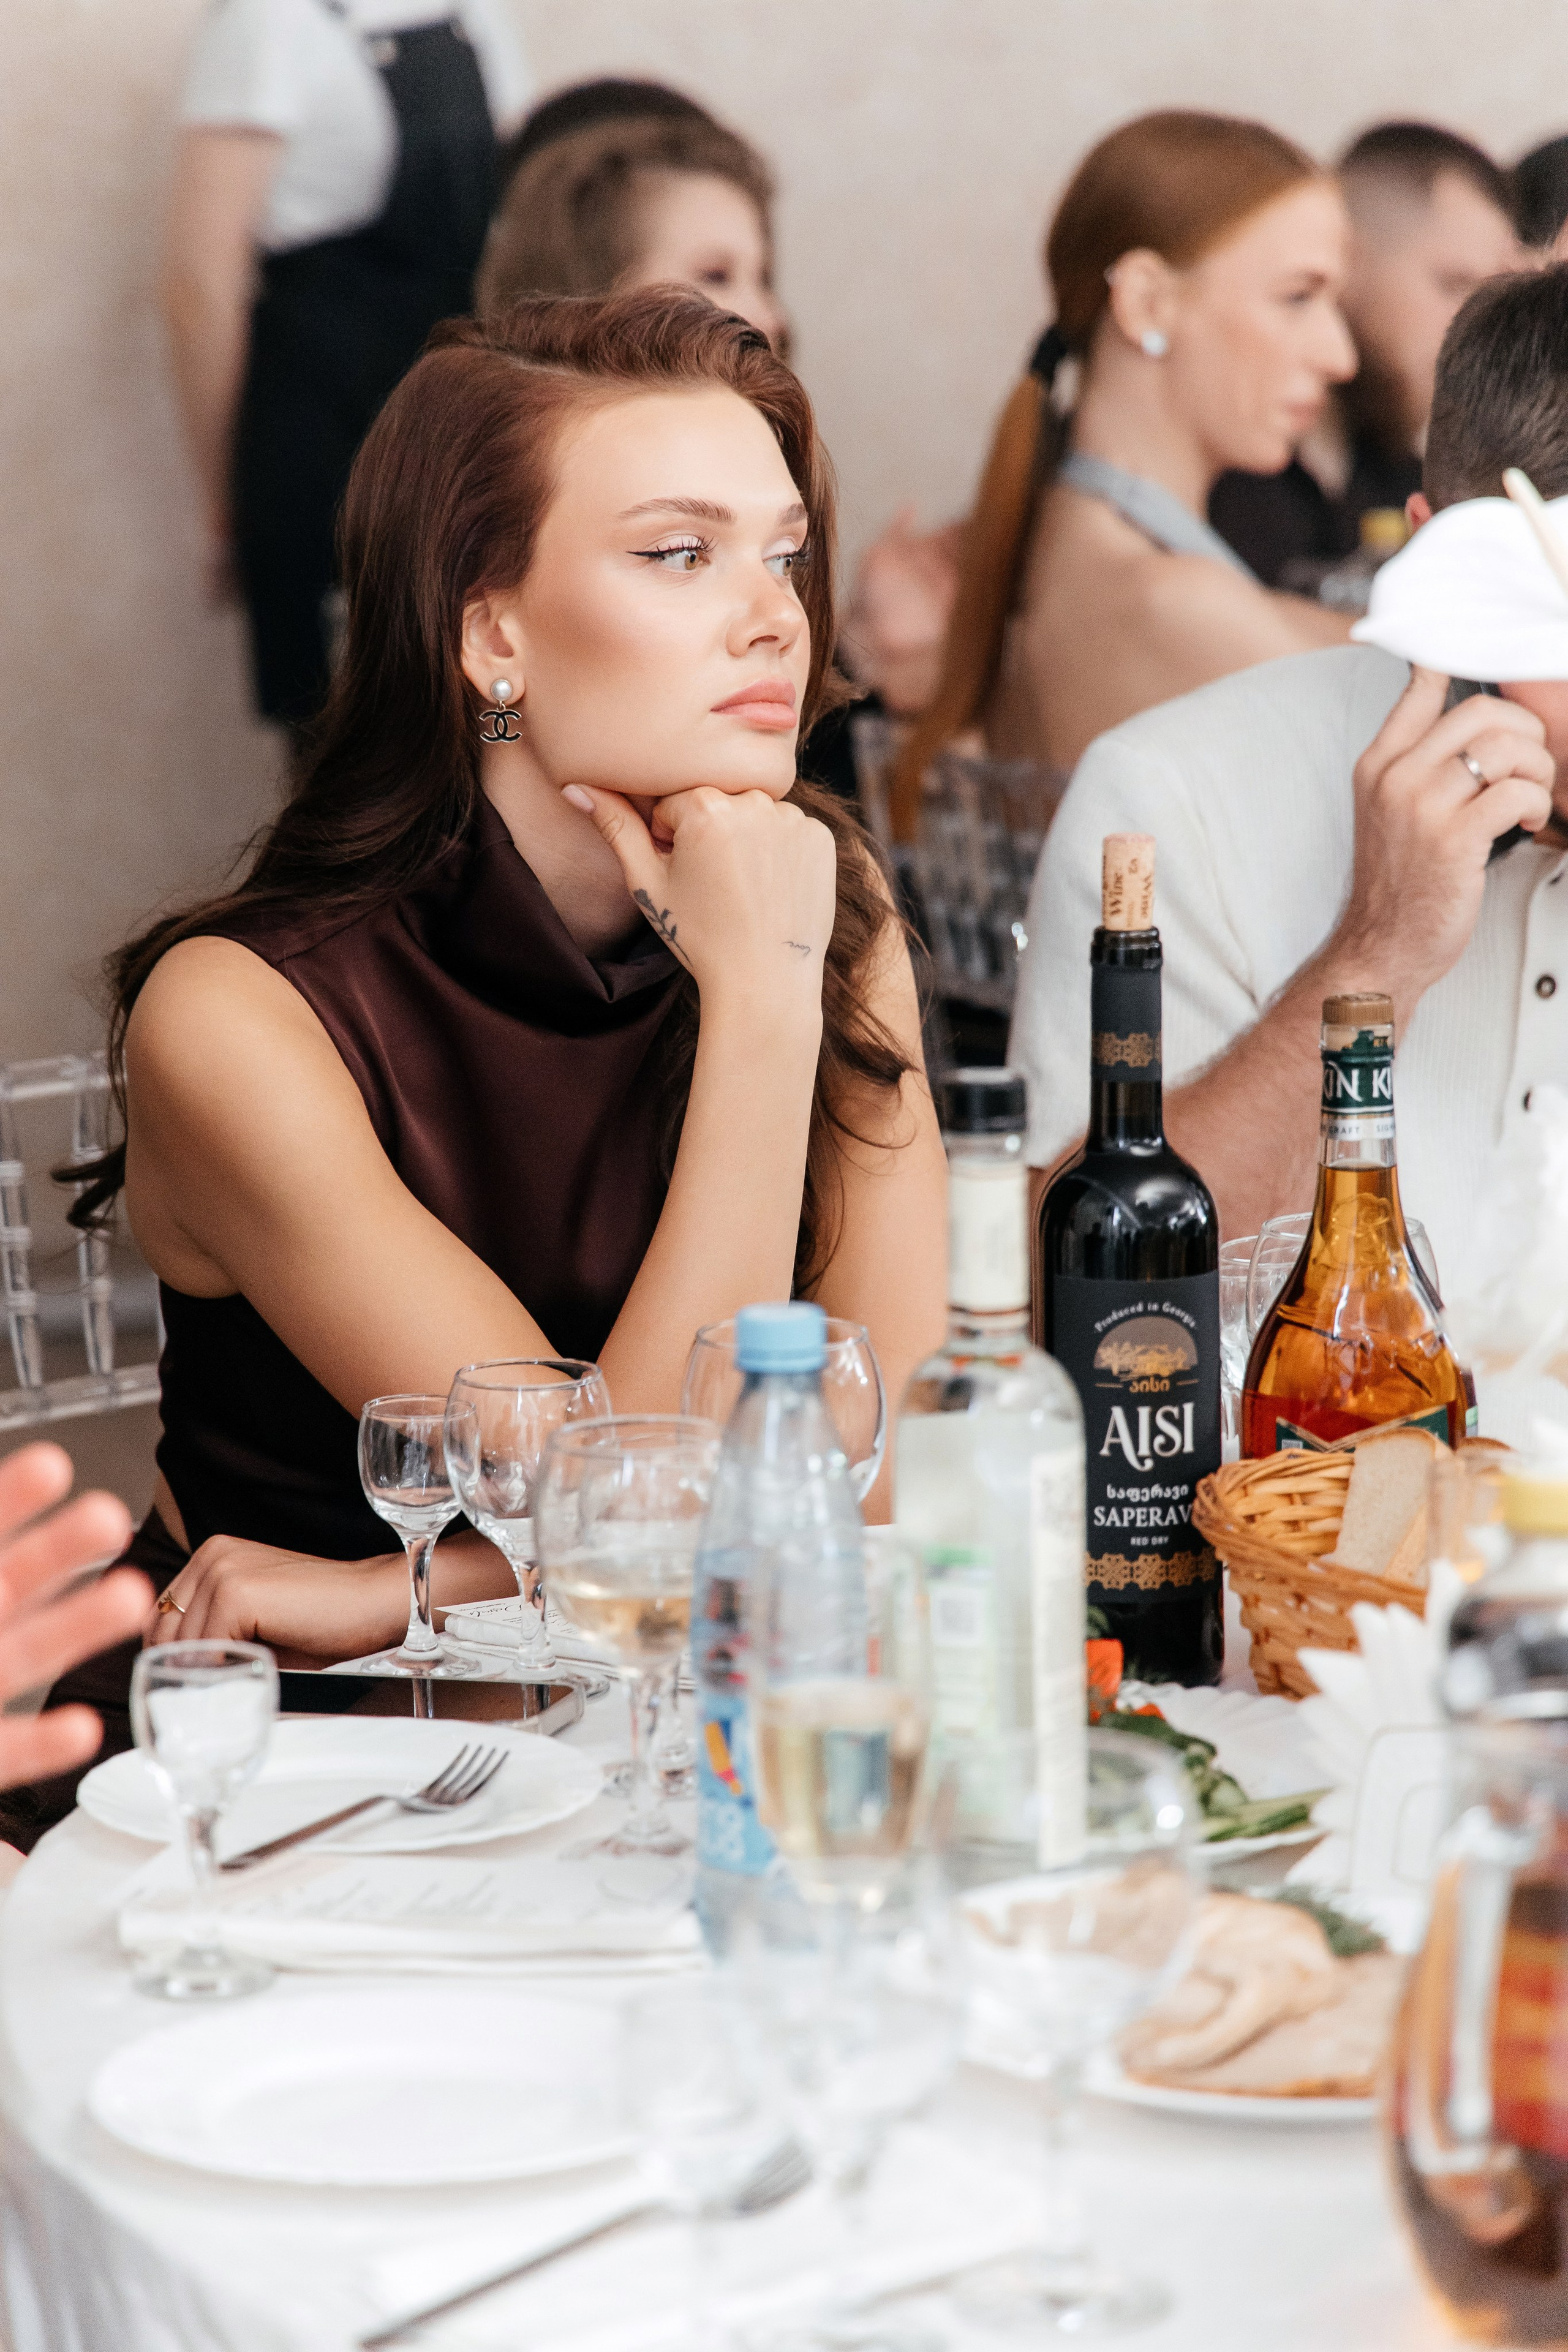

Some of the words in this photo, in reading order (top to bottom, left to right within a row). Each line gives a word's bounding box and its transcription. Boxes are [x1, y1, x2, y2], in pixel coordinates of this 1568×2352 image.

[1094, 1300, 1144, 1333] Produced
[1147, 1302, 1159, 1311] in
[1162, 1300, 1197, 1329] Georgia
[1099, 1402, 1194, 1471] AISI
[1106, 1483, 1189, 1502] საფერავი
[1093, 1503, 1193, 1528] SAPERAV
